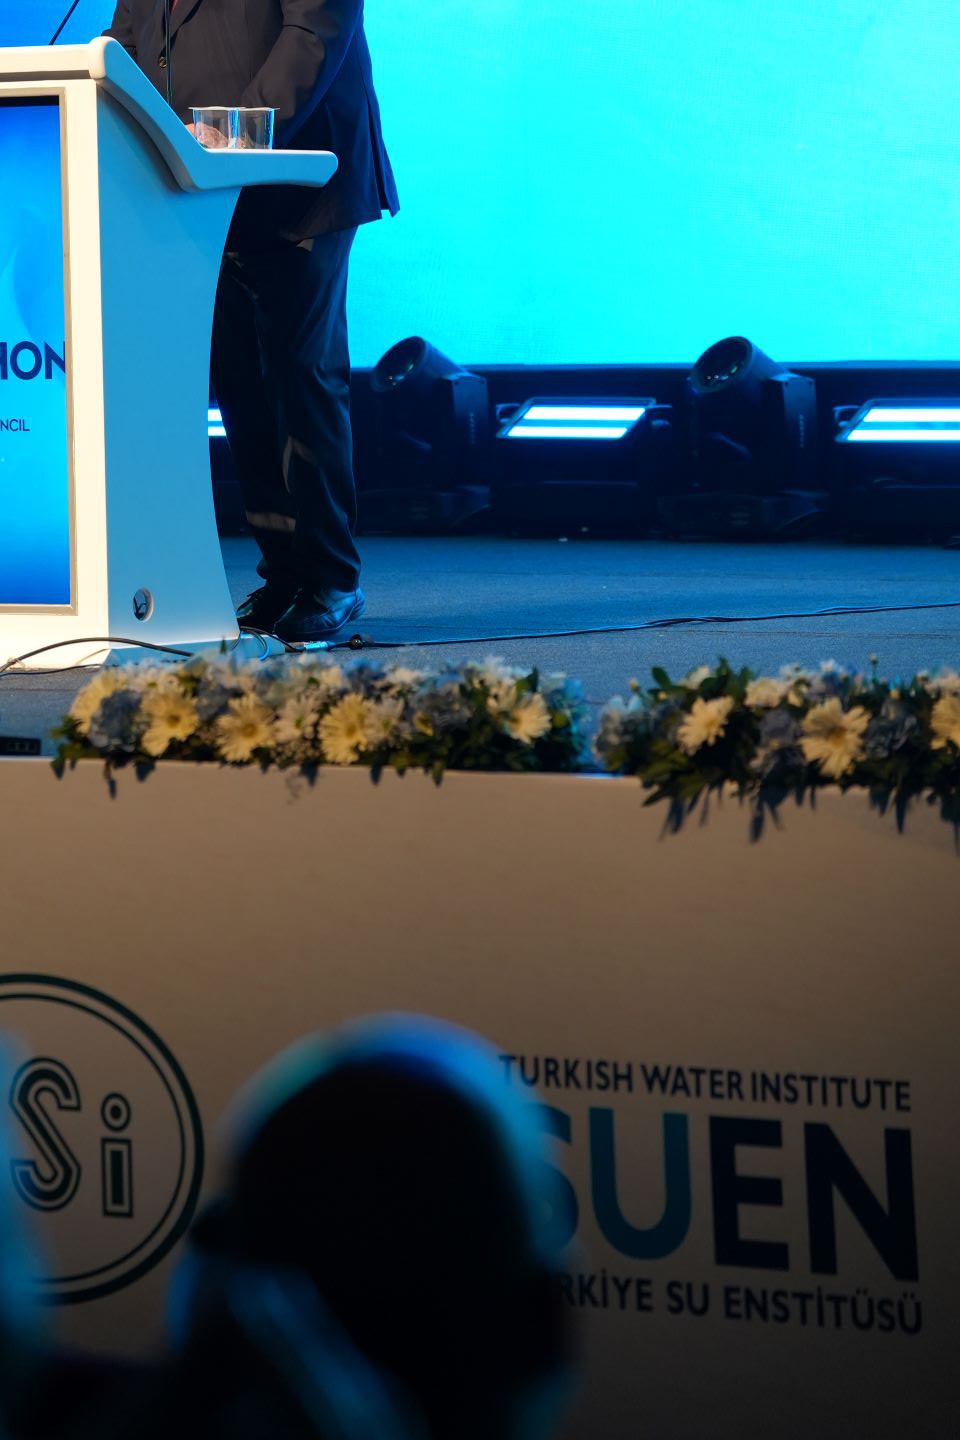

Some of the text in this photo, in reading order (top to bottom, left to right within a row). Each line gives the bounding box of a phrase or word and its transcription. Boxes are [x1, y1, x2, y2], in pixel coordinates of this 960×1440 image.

[497, 1053, 913, 1114] TURKISH WATER INSTITUTE
[555, 1269, 924, 1336] RKİYE SU ENSTİTÜSÜ
